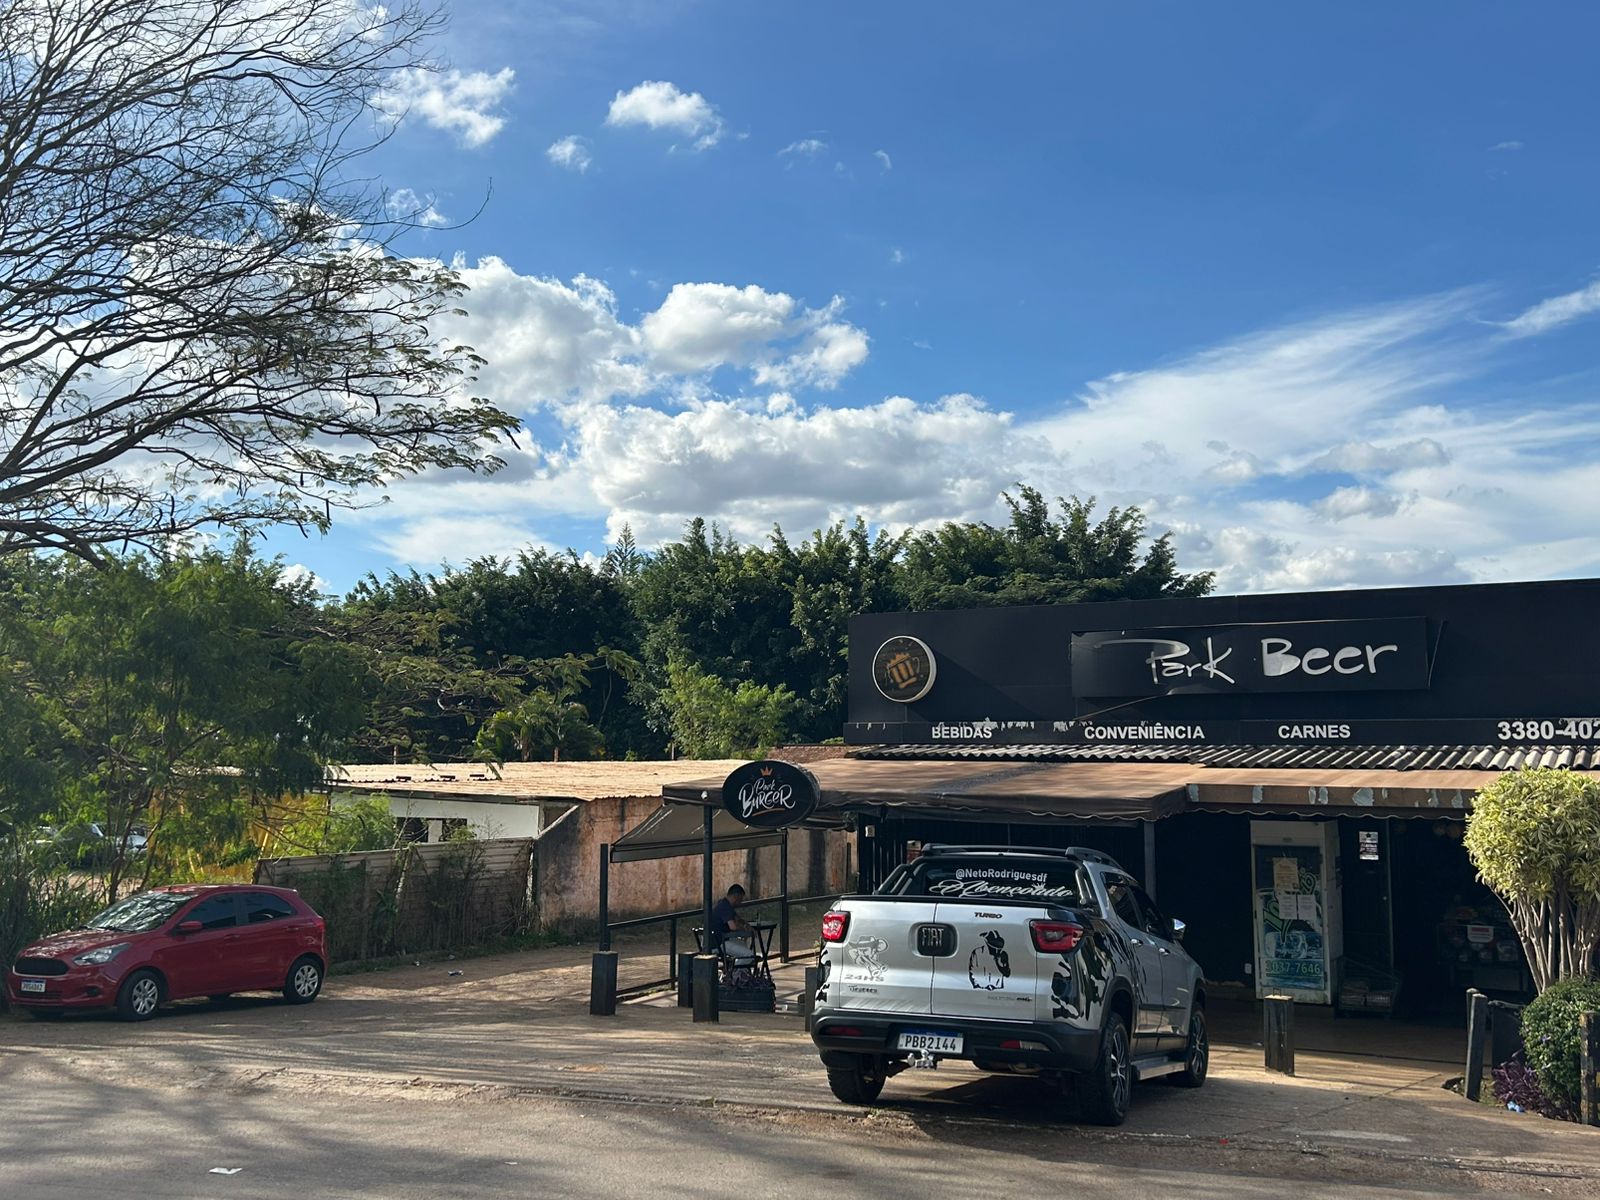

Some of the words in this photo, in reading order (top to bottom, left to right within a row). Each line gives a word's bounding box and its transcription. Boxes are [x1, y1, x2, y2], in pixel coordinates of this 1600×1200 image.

[1094, 637, 1235, 684] Park
[1261, 637, 1398, 677] Beer
[932, 725, 992, 739] BEBIDAS
[1084, 723, 1205, 740] CONVENIÊNCIA
[1278, 725, 1351, 739] CARNES
[955, 868, 1047, 882] @NetoRodriguesdf
[922, 927, 944, 946] FIAT
